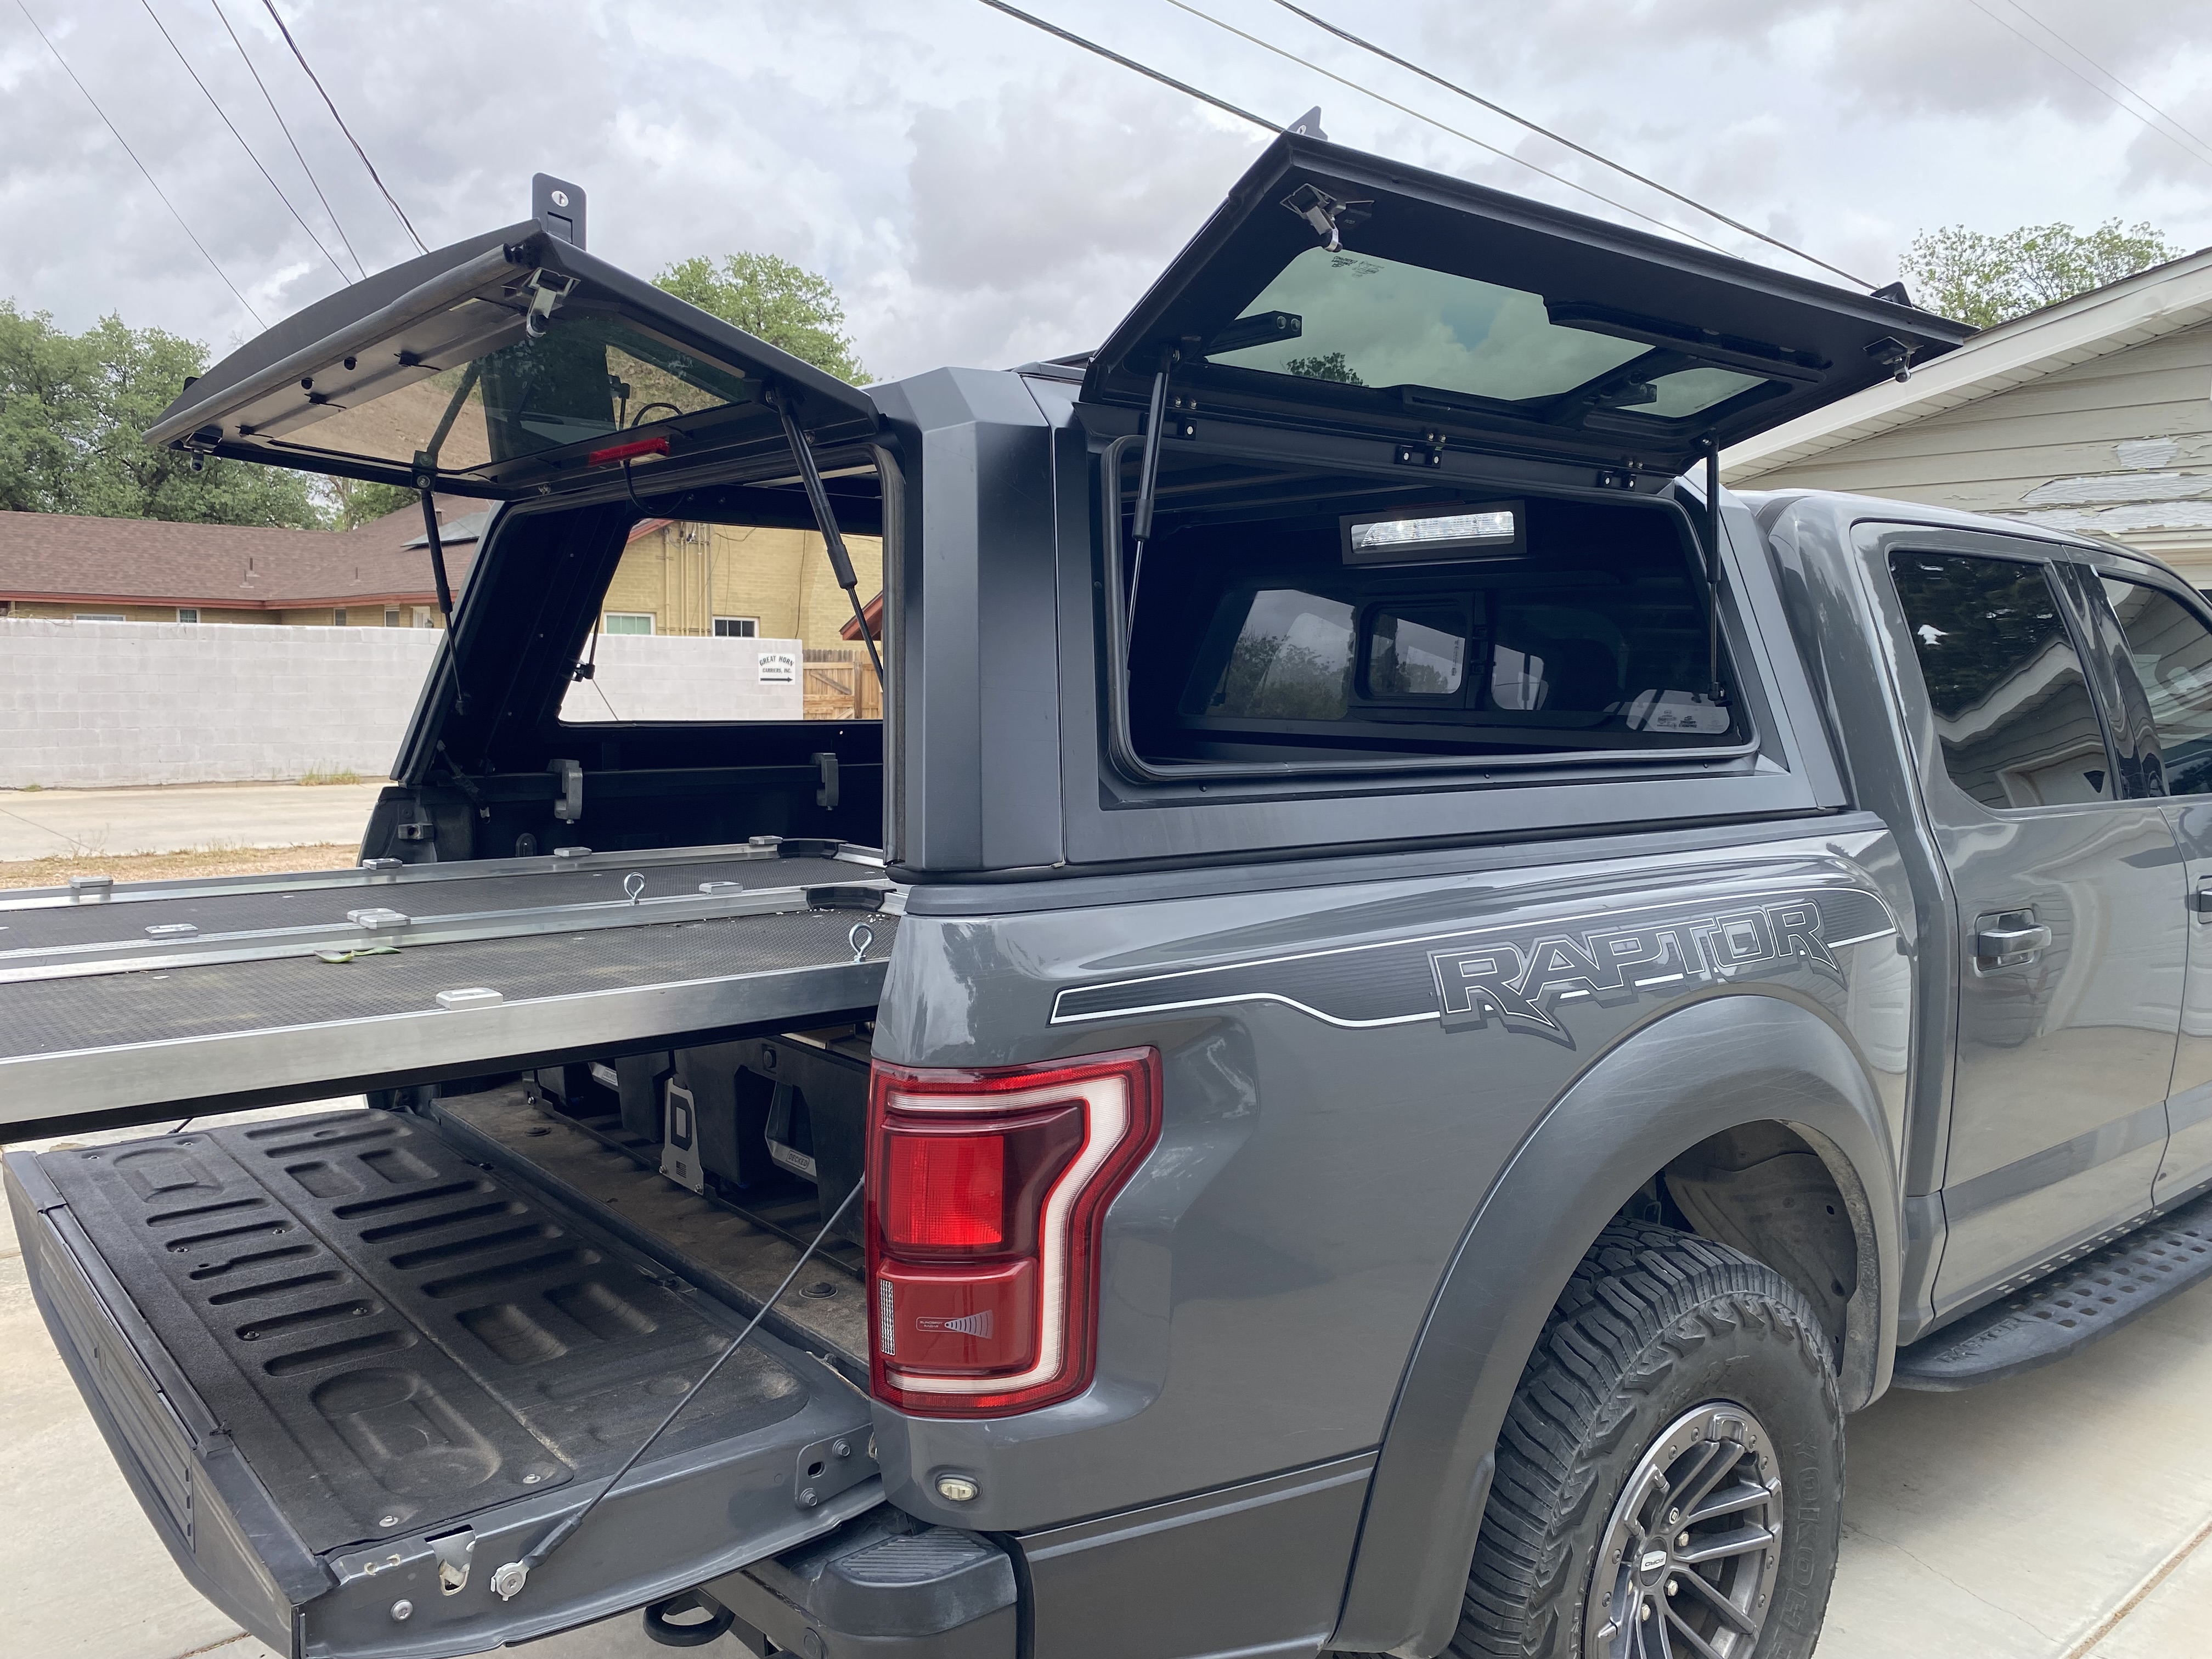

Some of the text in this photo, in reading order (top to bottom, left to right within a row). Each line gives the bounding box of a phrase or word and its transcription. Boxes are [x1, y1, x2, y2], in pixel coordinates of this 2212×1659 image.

[759, 656, 794, 666] GREAT HORN
[1431, 900, 1841, 1036] RAPTOR
[788, 1153, 808, 1166] DECKED
[1645, 1558, 1664, 1566] FORD
